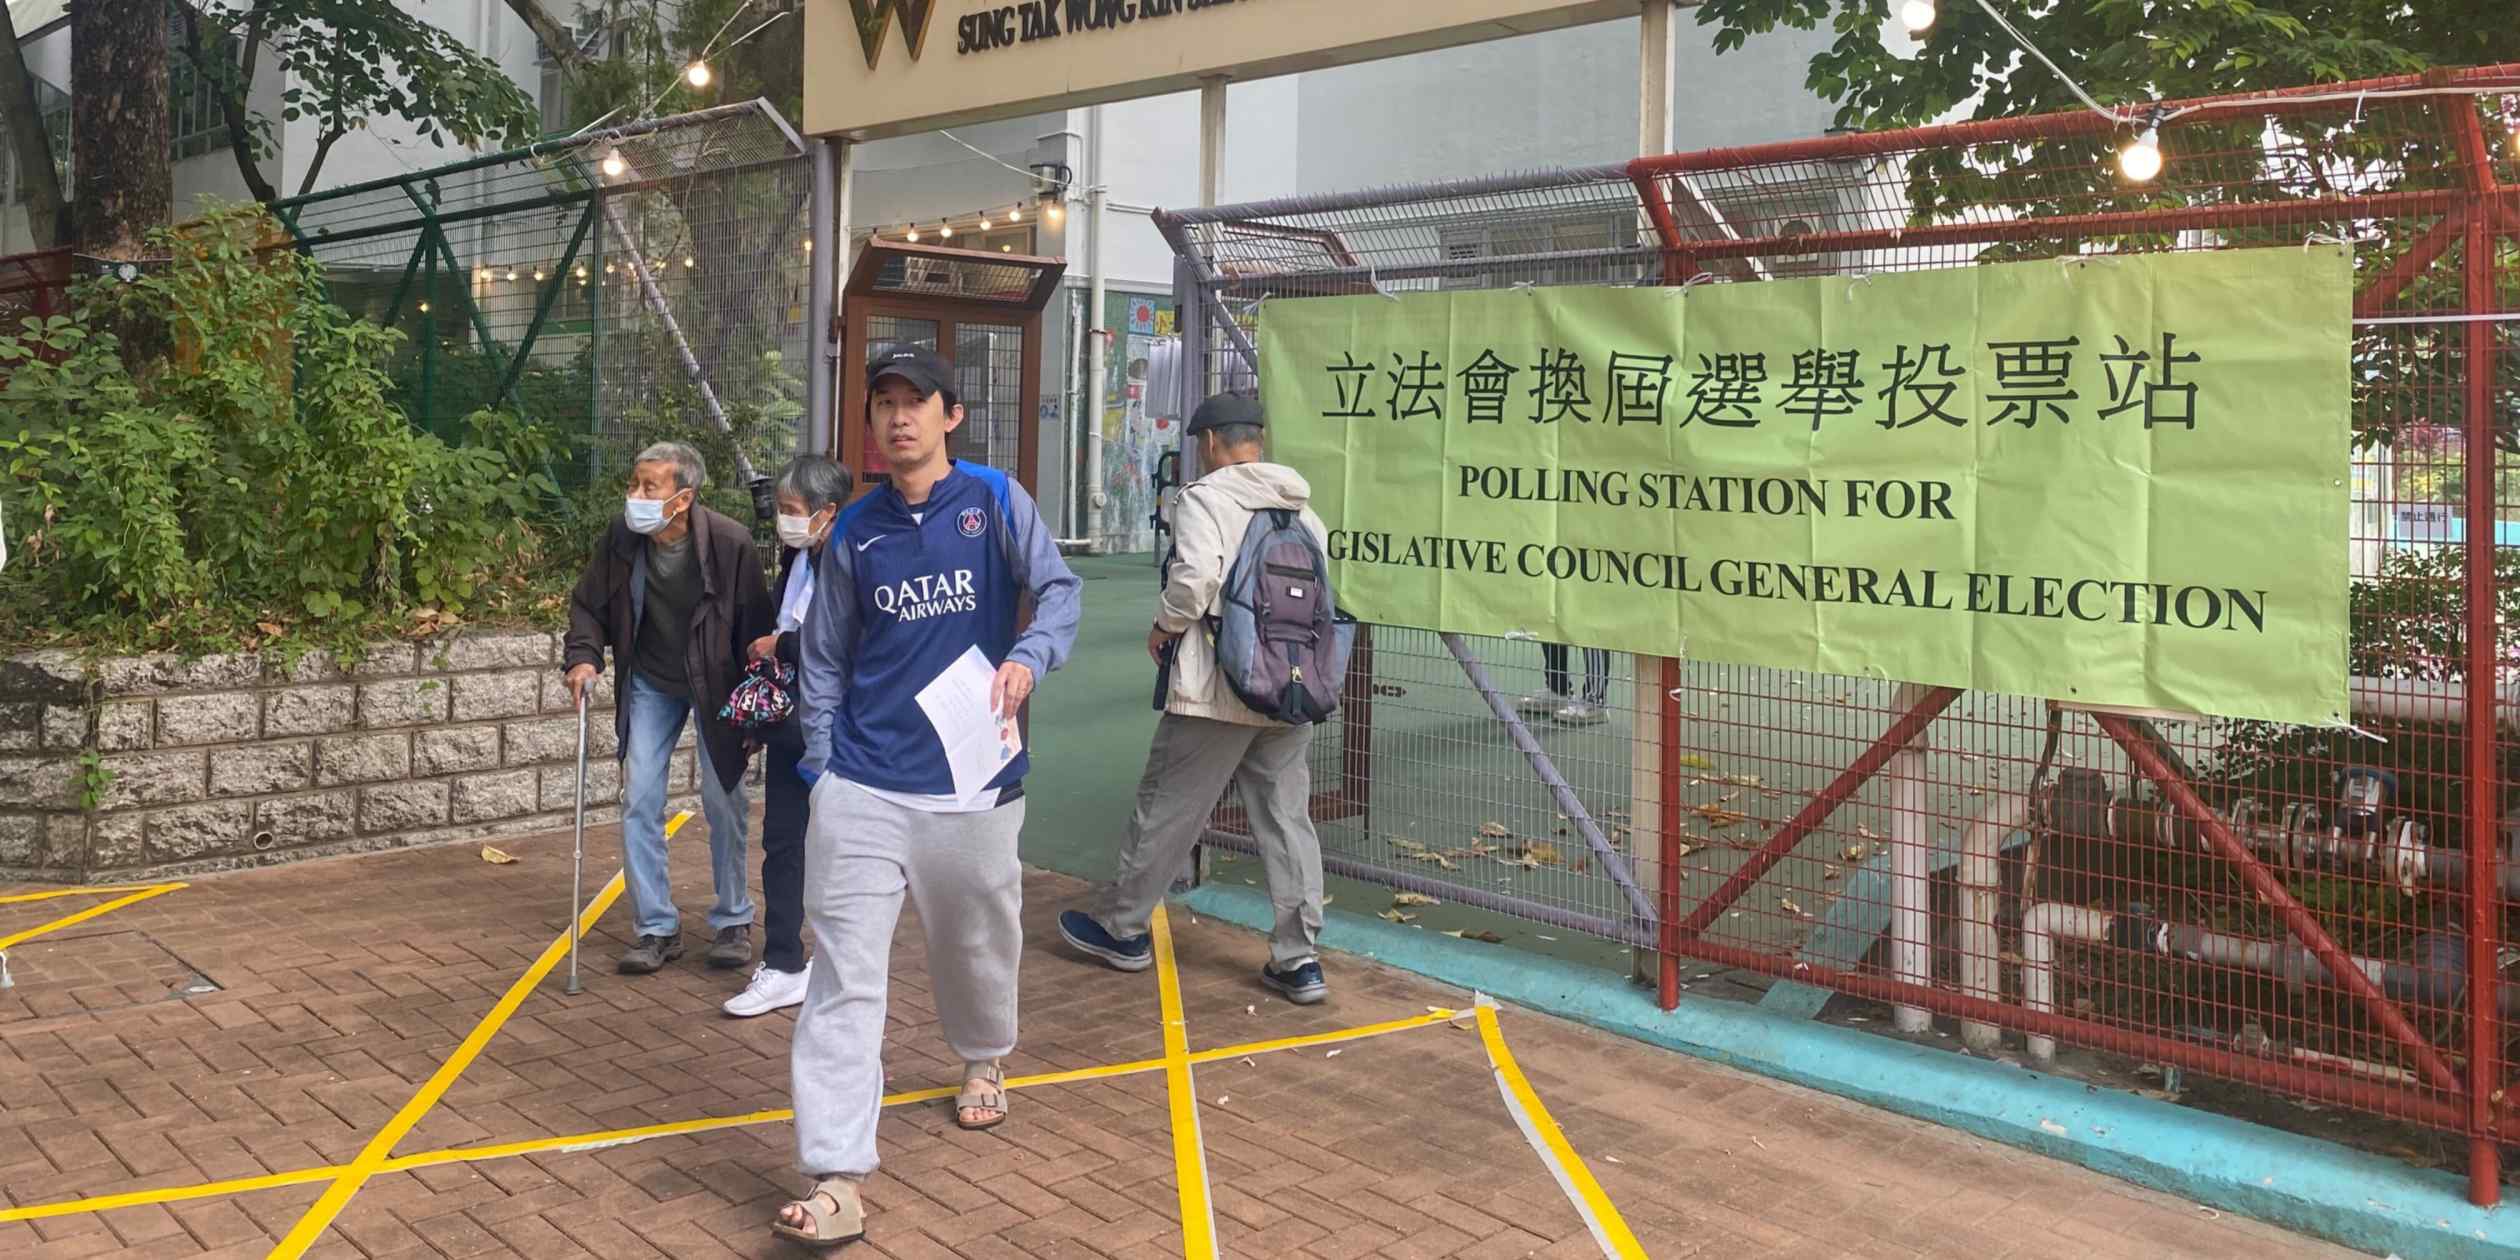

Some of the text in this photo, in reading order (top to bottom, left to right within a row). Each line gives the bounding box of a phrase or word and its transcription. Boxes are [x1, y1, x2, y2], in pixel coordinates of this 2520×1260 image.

[957, 5, 1016, 55] SUNG
[1017, 0, 1062, 43] TAK
[1321, 332, 2202, 431] 立法會換屆選舉投票站
[1459, 465, 1956, 520] POLLING STATION FOR
[874, 569, 976, 614] QATAR
[898, 595, 977, 623] AIRWAYS
[1327, 529, 2268, 634] GISLATIVE COUNCIL GENERAL ELECTION
